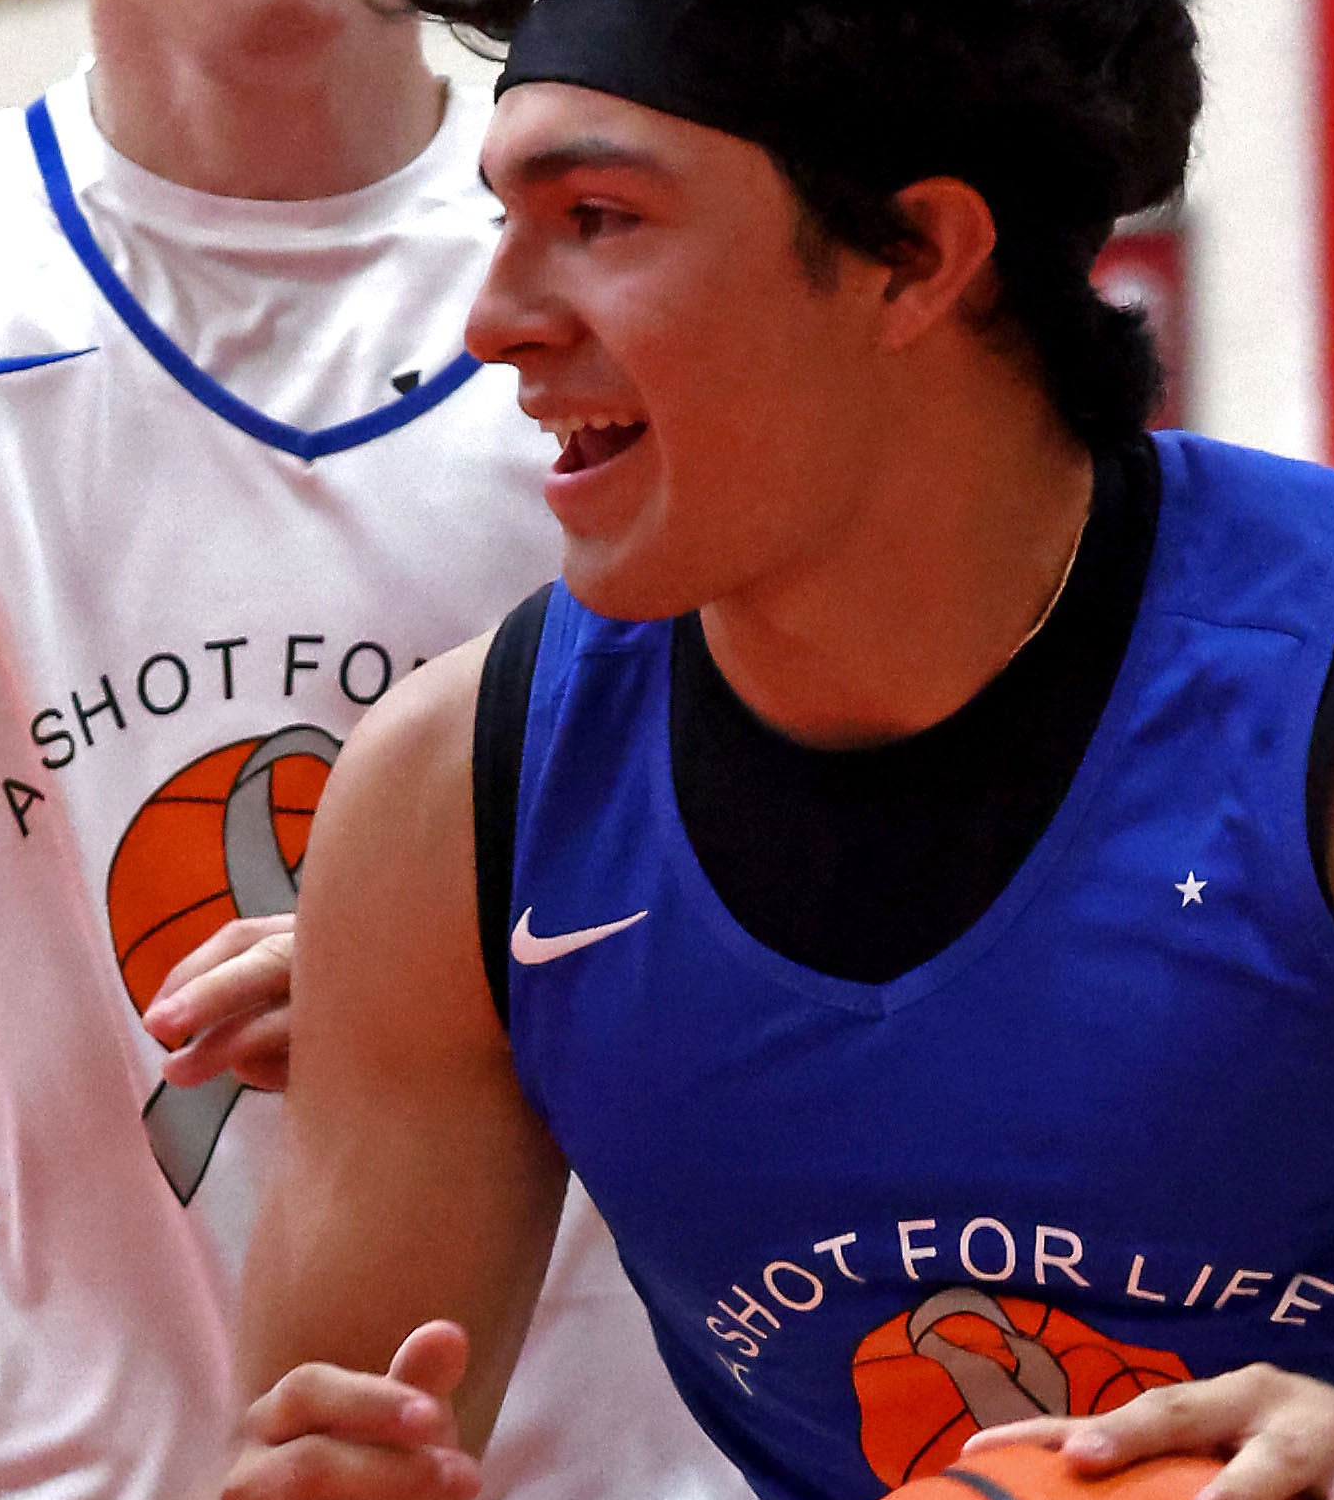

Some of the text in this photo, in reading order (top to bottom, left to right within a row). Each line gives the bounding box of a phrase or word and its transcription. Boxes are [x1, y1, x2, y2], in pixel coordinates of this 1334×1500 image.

[1, 633, 430, 838] A SHOT FO
[704, 1230, 867, 1359] SHOT
[896, 1215, 1092, 1289] FOR
